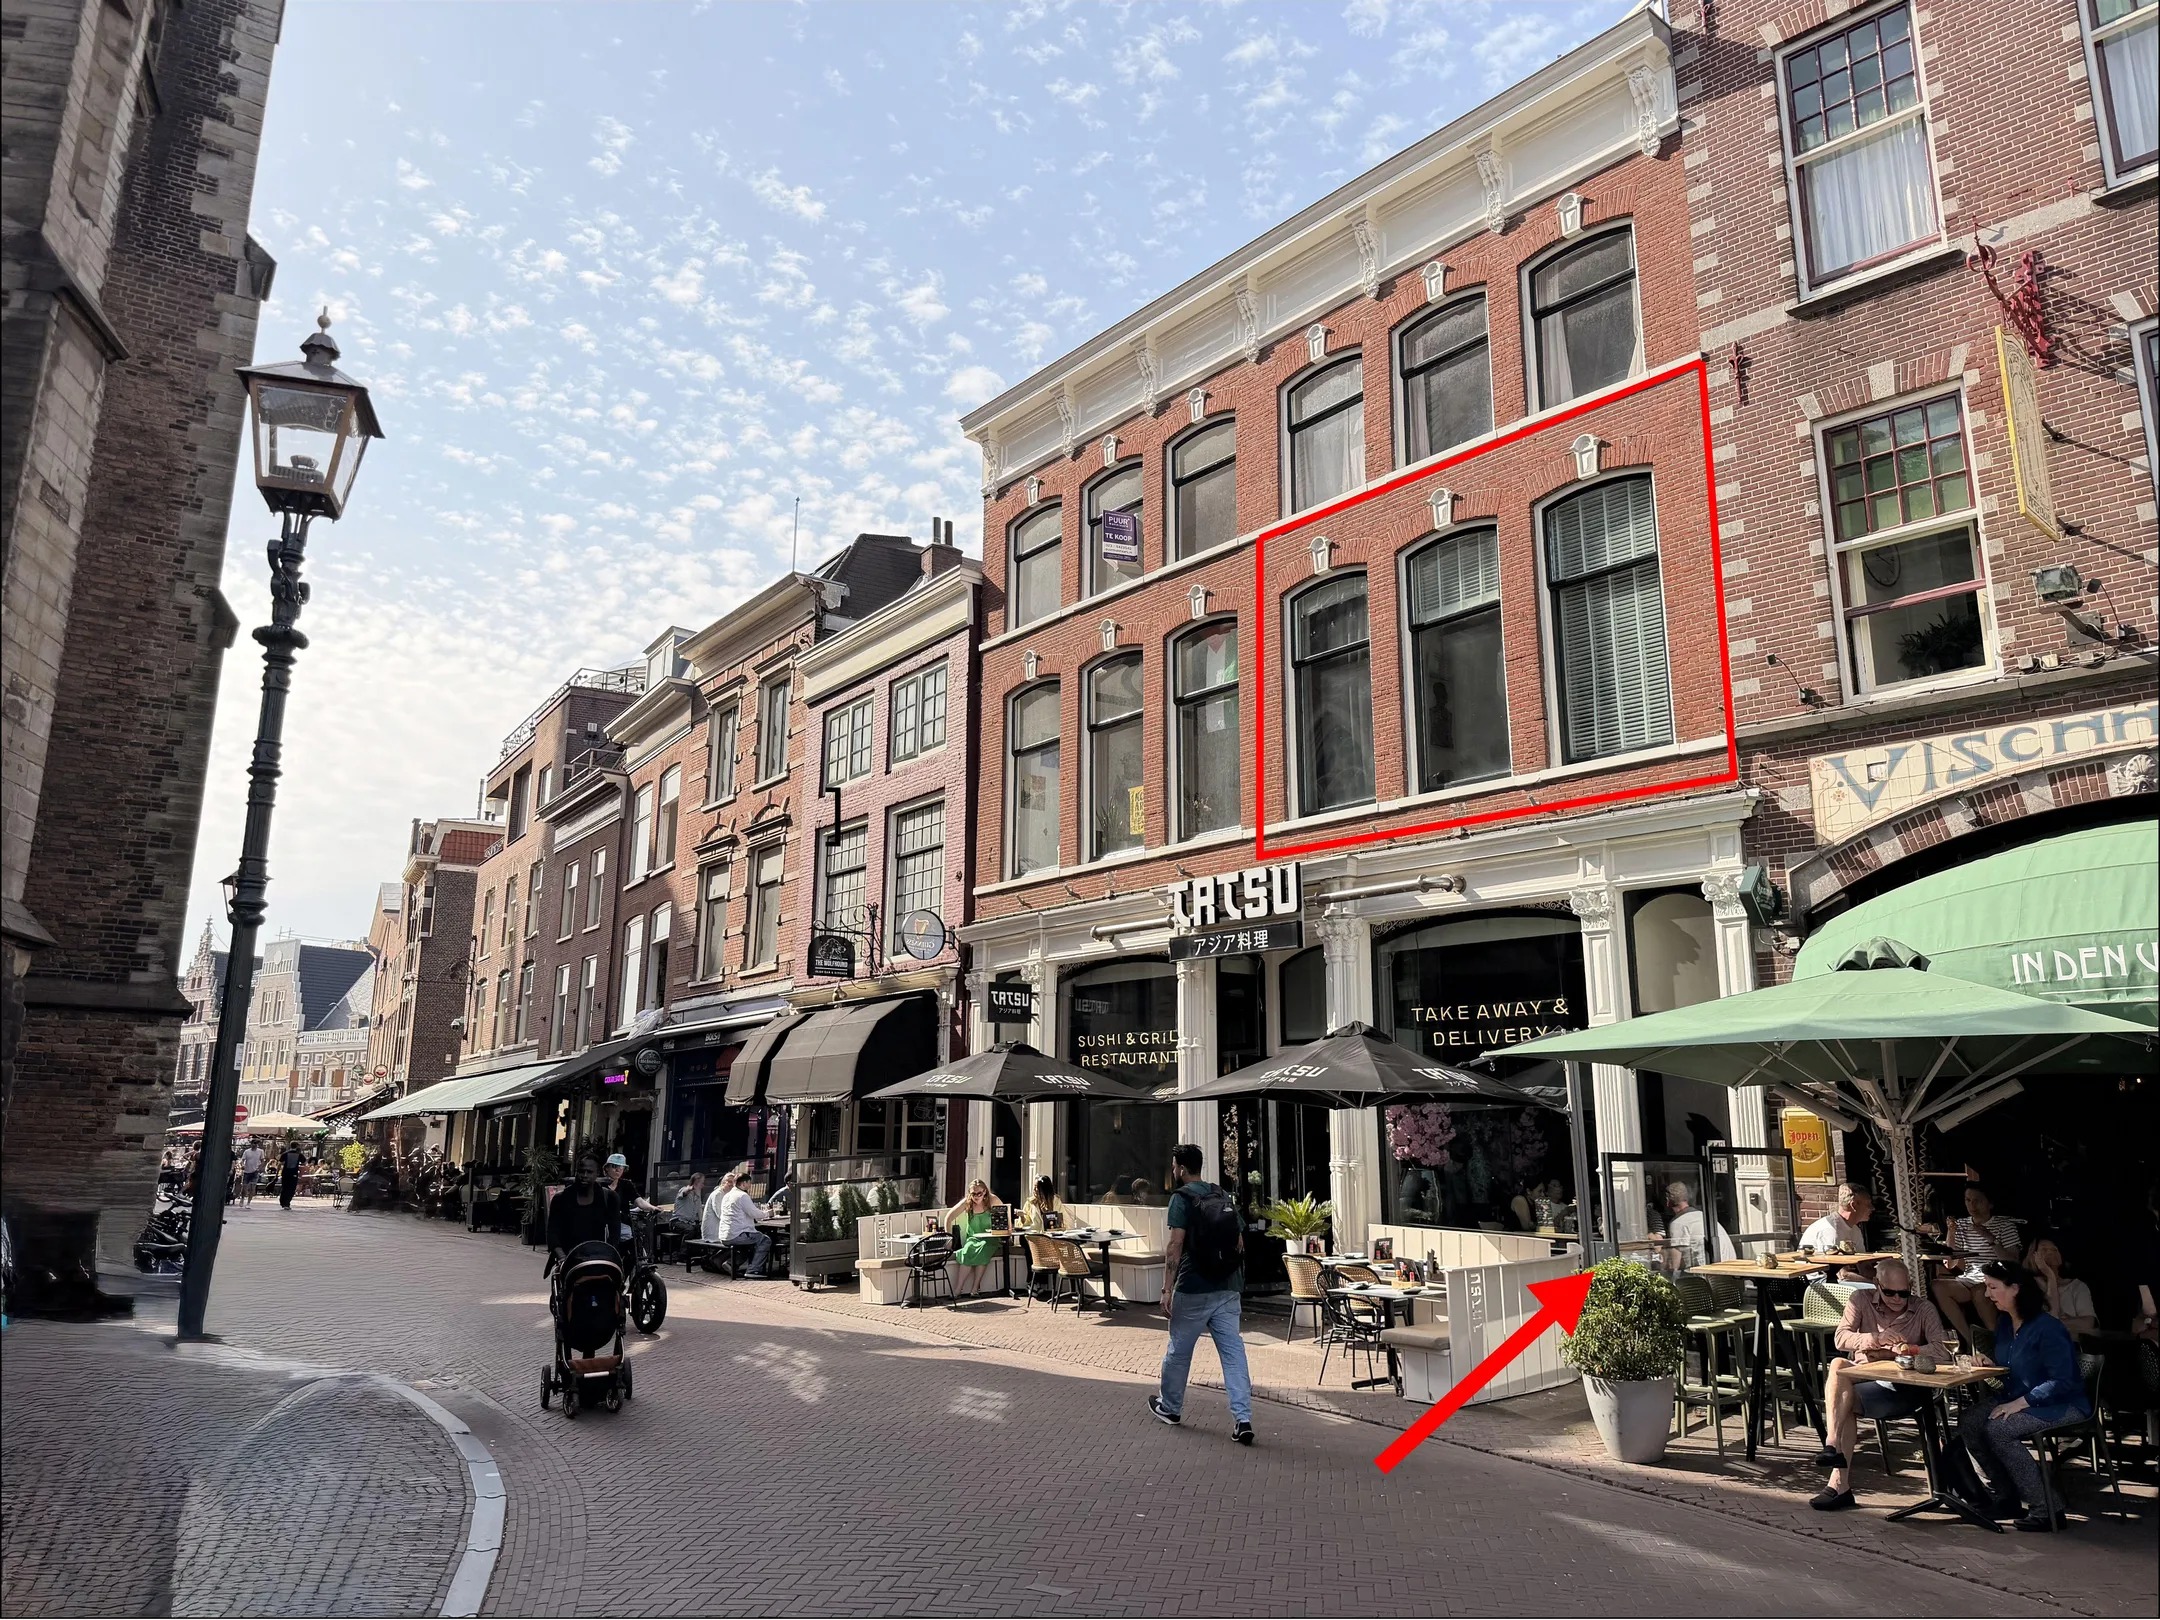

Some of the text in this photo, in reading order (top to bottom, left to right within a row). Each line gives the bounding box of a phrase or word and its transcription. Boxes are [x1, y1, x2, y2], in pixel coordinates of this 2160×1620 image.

[1105, 532, 1113, 540] TE
[1168, 862, 1299, 927] TATSU
[1194, 929, 1269, 956] アジア料理
[2011, 951, 2046, 985] IN
[2052, 944, 2129, 981] DEN
[990, 990, 1030, 1007] TATSU
[1411, 998, 1569, 1022] TAKE AWAY &
[1078, 1033, 1121, 1048] SUSHI
[1126, 1032, 1136, 1045] &
[1433, 1025, 1549, 1046] DELIVERY
[1081, 1050, 1178, 1067] RESTAURANT
[1034, 1074, 1091, 1086] TATSU
